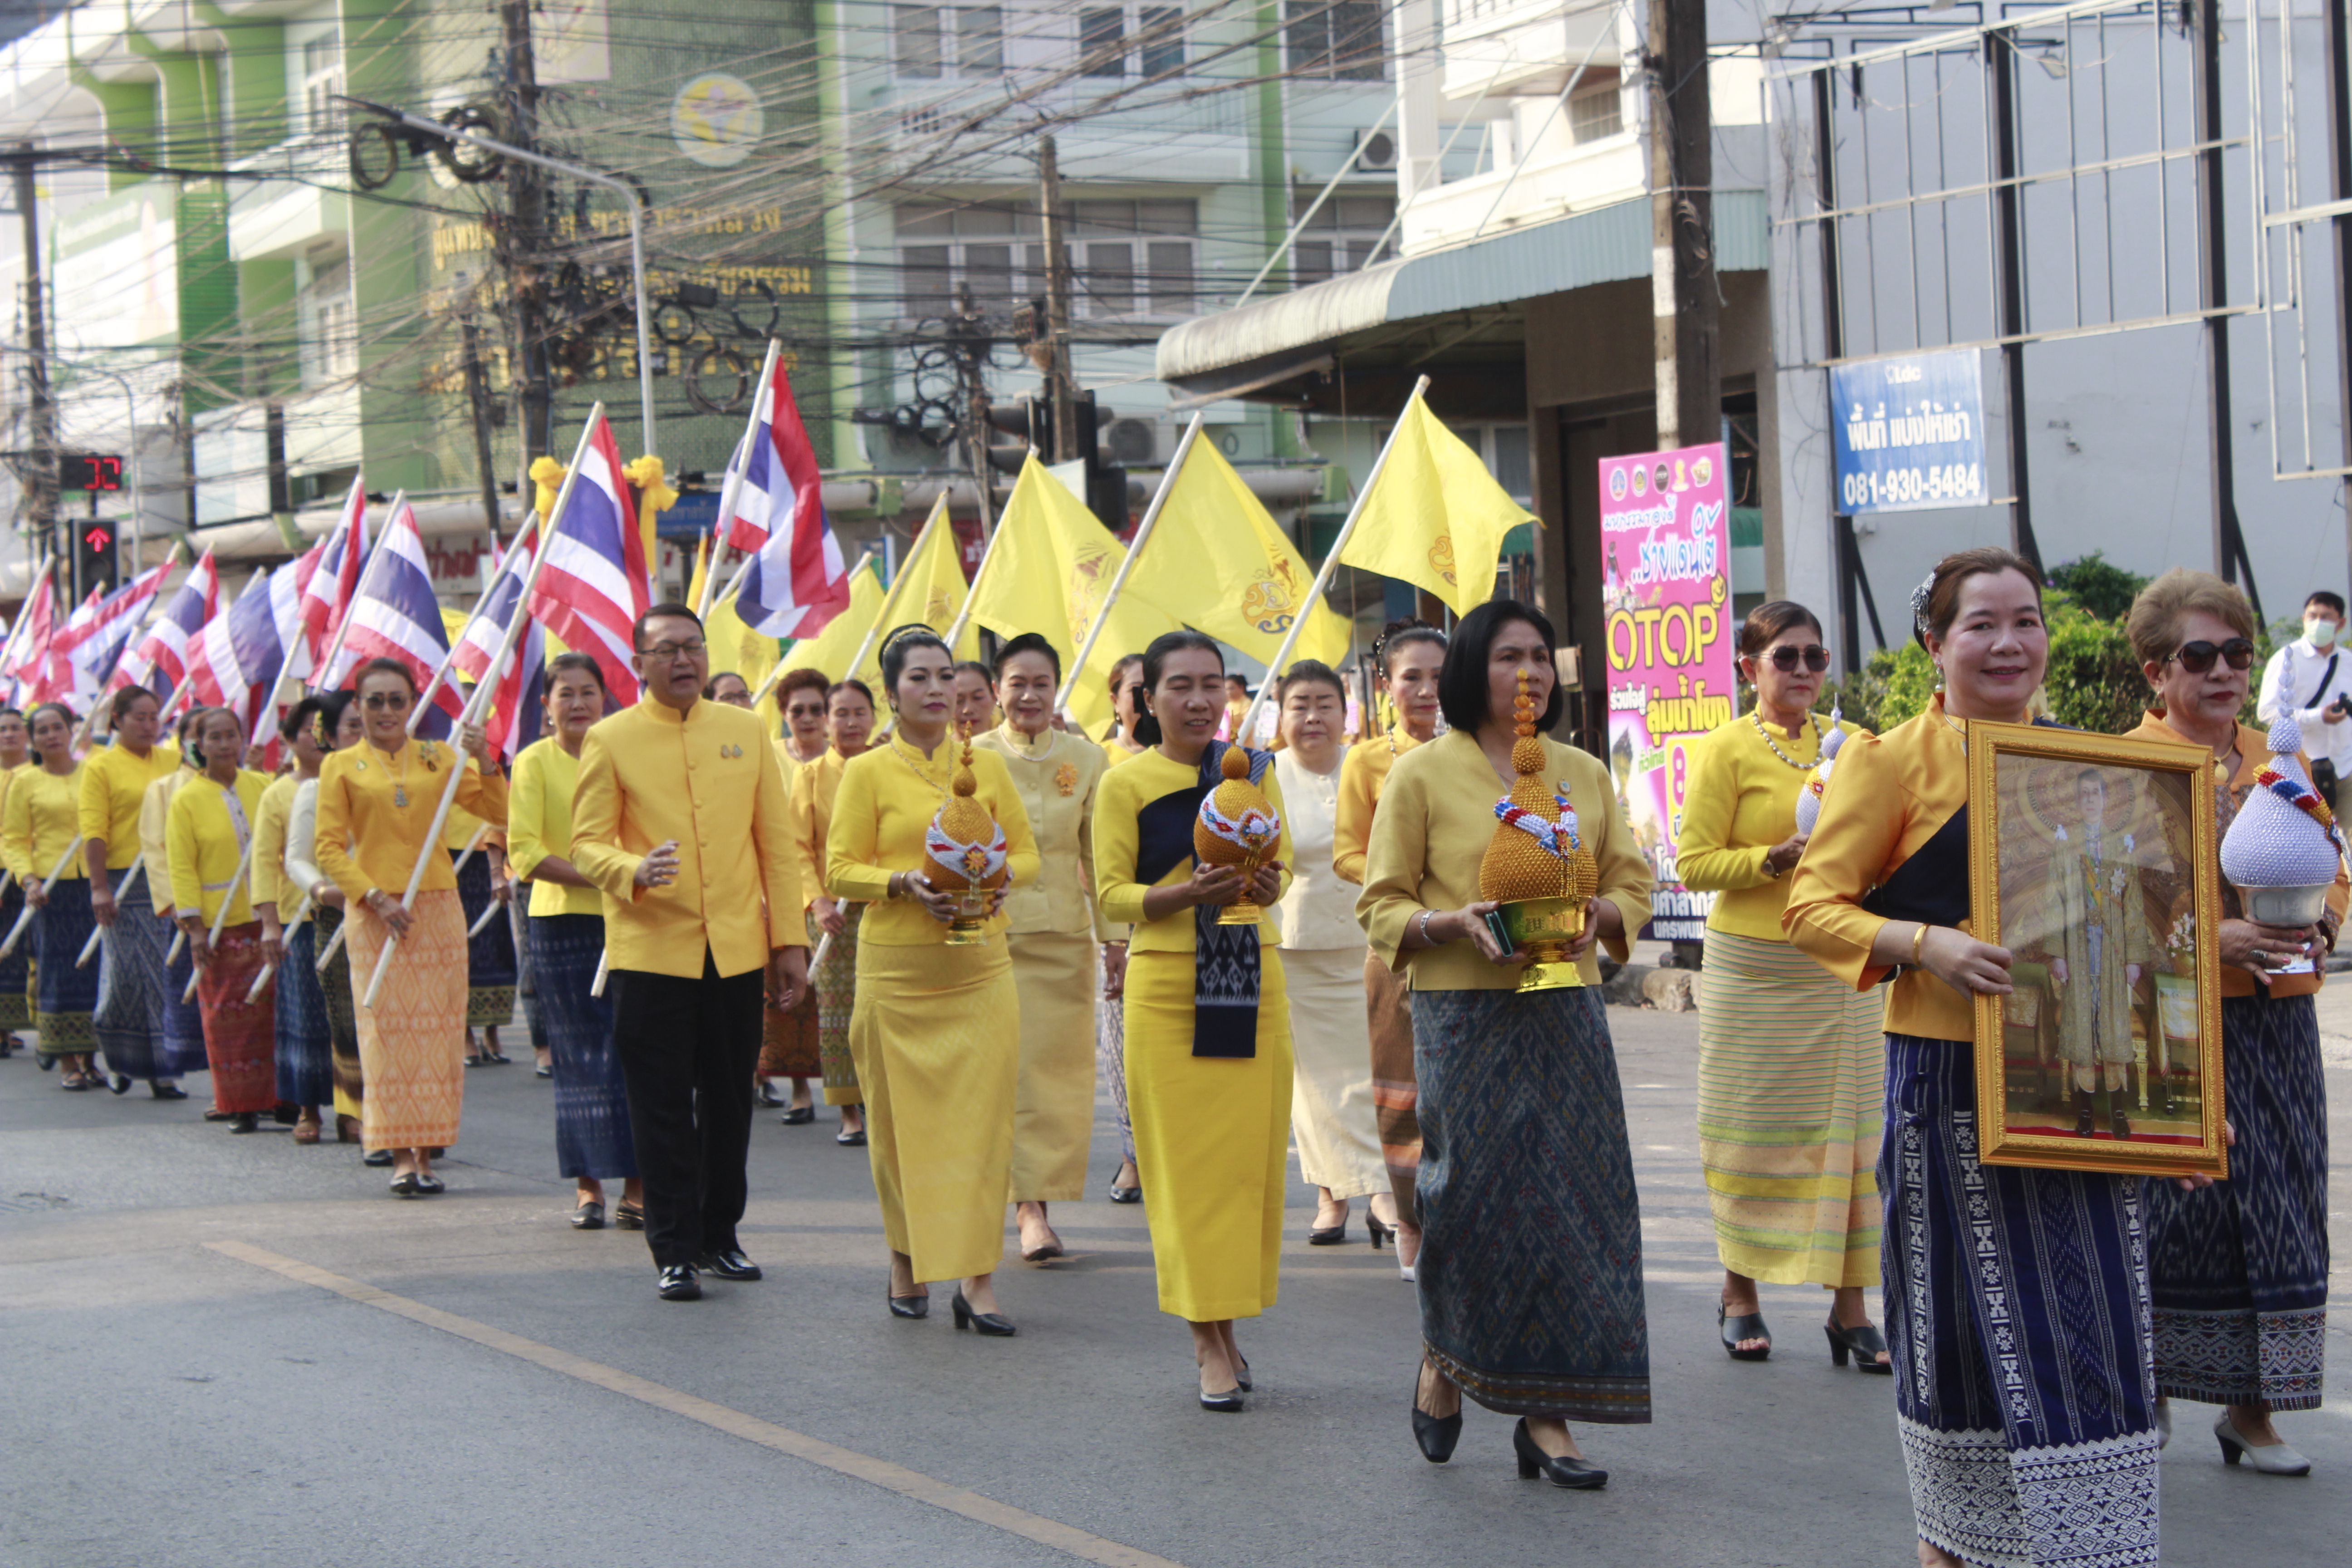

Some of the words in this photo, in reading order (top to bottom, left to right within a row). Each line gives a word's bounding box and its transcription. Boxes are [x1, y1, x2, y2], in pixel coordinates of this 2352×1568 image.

[1846, 402, 1887, 451] พื้นที่
[1889, 400, 1971, 447] แบ่งให้เช่า
[1844, 463, 1980, 506] 081-930-5484
[1607, 604, 1719, 671] OTOP
[1610, 681, 1646, 716] ร่วมใจสู่
